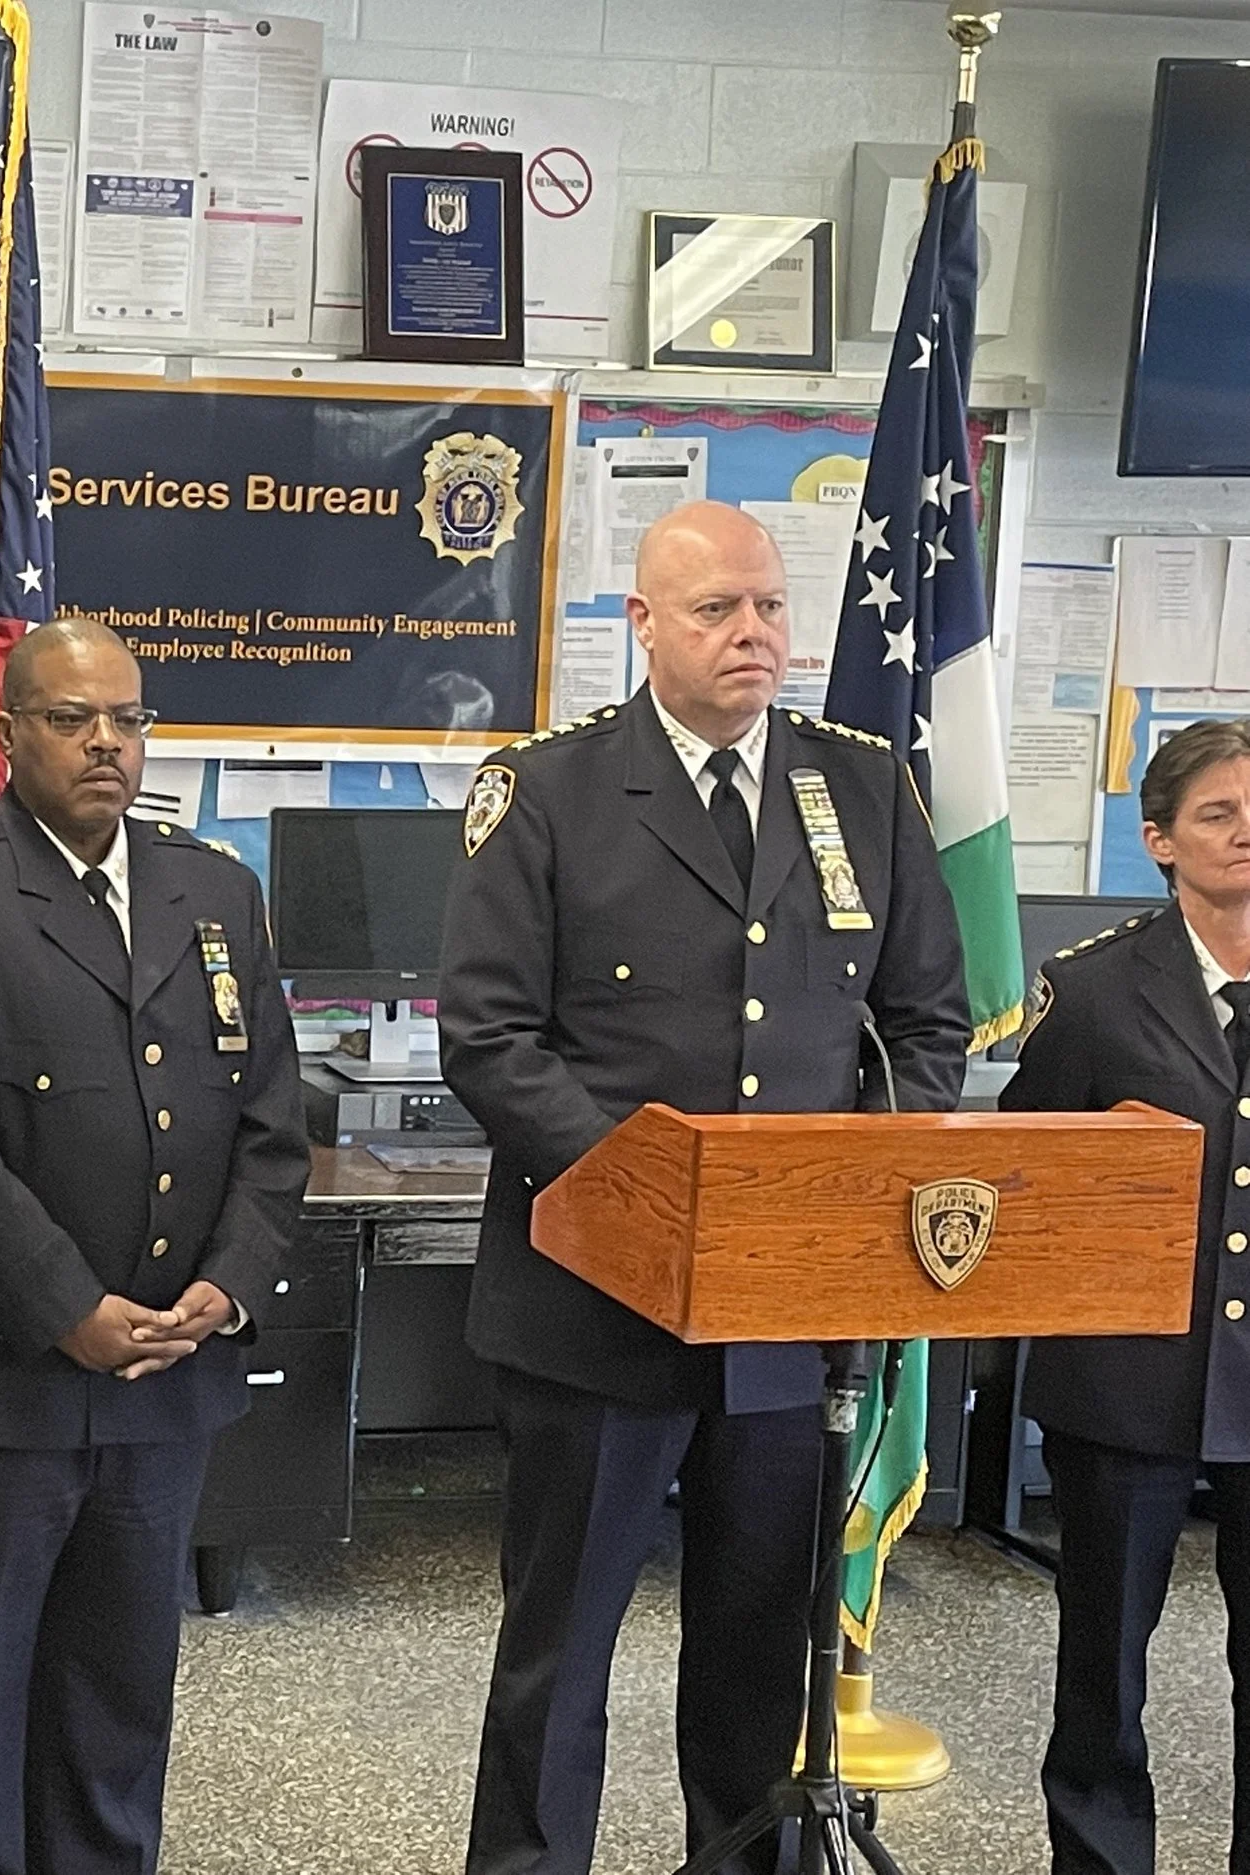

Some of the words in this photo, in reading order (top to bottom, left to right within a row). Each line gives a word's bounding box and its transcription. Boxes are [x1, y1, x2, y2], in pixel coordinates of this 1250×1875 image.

[115, 34, 141, 48] THE
[145, 35, 178, 51] LAW
[431, 113, 516, 138] WARNING!
[48, 467, 230, 510] Services
[247, 474, 400, 516] Bureau
[167, 607, 250, 635] Policing
[266, 611, 389, 639] Community
[393, 614, 517, 640] Engagement
[125, 637, 225, 664] Employee
[230, 640, 352, 666] Recognition
[936, 1187, 977, 1199] POLICE
[920, 1198, 991, 1218] DEPARTMENT
